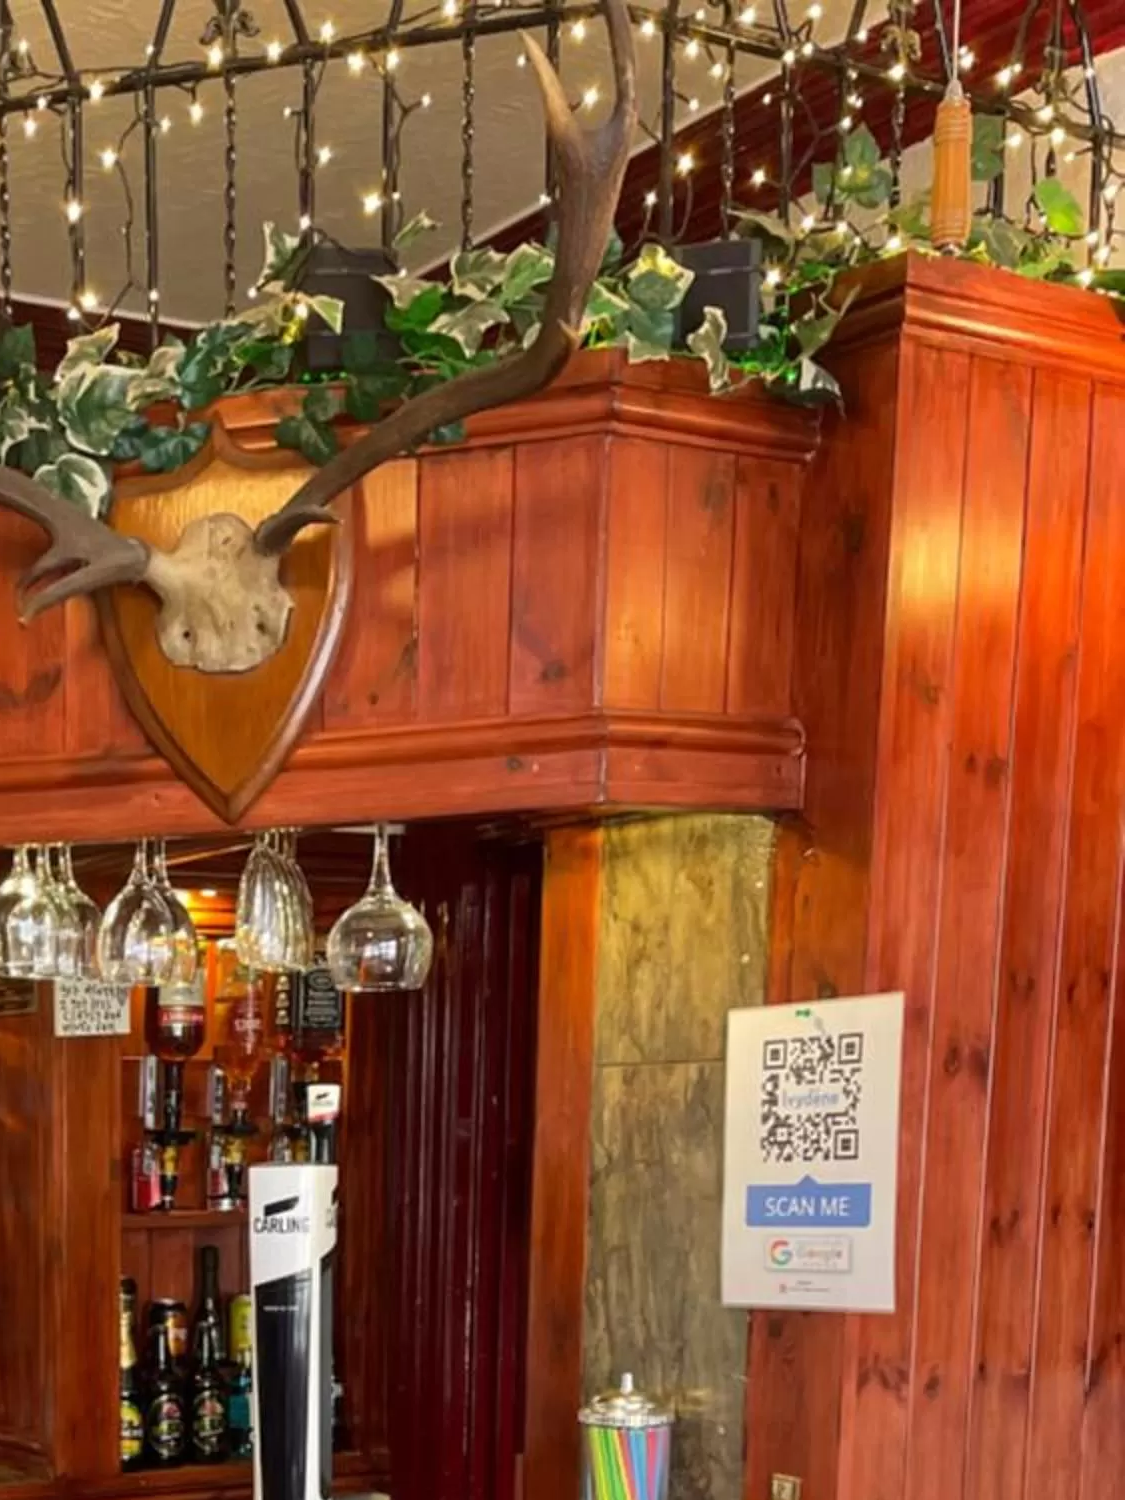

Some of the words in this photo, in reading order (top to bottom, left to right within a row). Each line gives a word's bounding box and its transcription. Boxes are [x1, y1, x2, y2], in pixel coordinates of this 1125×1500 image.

[765, 1196, 815, 1217] SCAN
[820, 1195, 850, 1217] ME
[254, 1217, 310, 1233] CARLING
